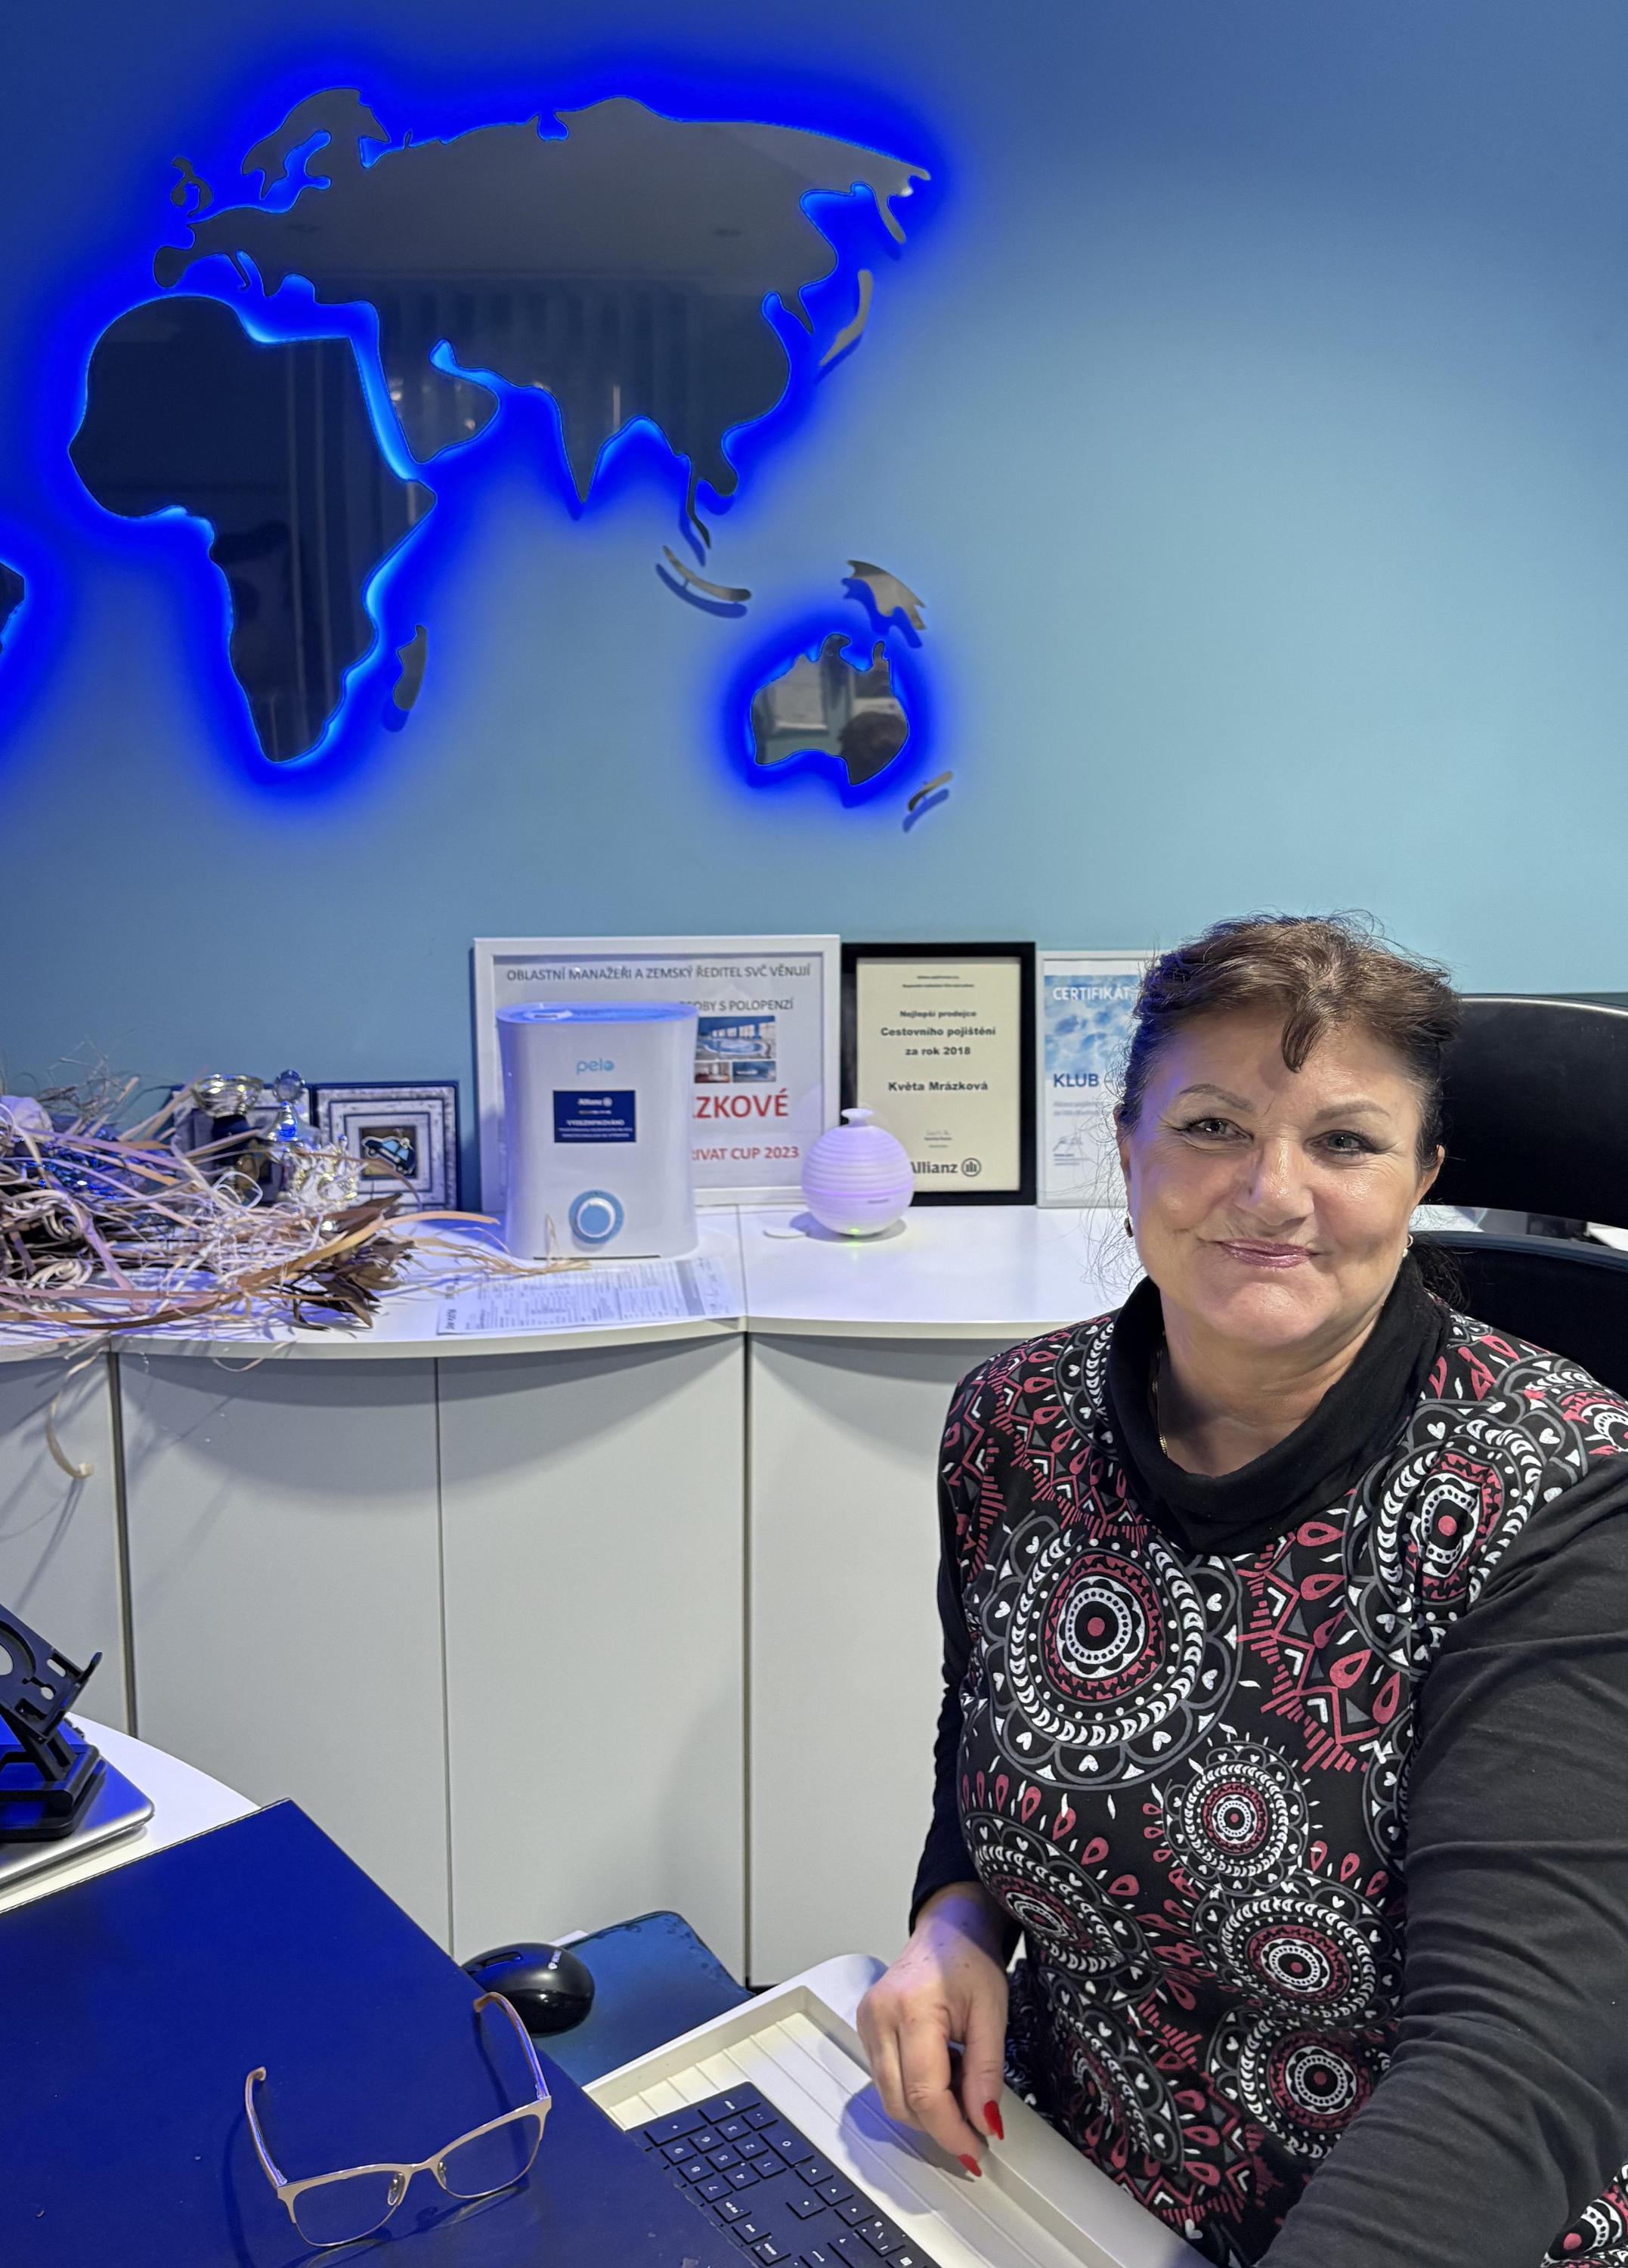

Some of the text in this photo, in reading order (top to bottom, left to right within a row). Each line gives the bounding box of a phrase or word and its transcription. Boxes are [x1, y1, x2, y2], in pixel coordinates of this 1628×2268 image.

[507, 962, 811, 981] OBLASTNÍ MANAŽEŘI A ZEMSKÝ ŘEDITEL SVČ VĚNUJÍ
[679, 998, 794, 1012] OBY S POLOPENZÍ
[900, 1010, 976, 1019] Nejlepší prodejce
[881, 1027, 996, 1038] Cestovního pojištění
[921, 1047, 939, 1055] rok
[943, 1046, 971, 1055] 2018
[888, 1080, 989, 1091] Květa Mrázková
[1054, 1074, 1100, 1088] KLUB
[693, 1088, 788, 1118] ZKOVÉ
[731, 1147, 760, 1160] CUP
[764, 1145, 799, 1159] 2023
